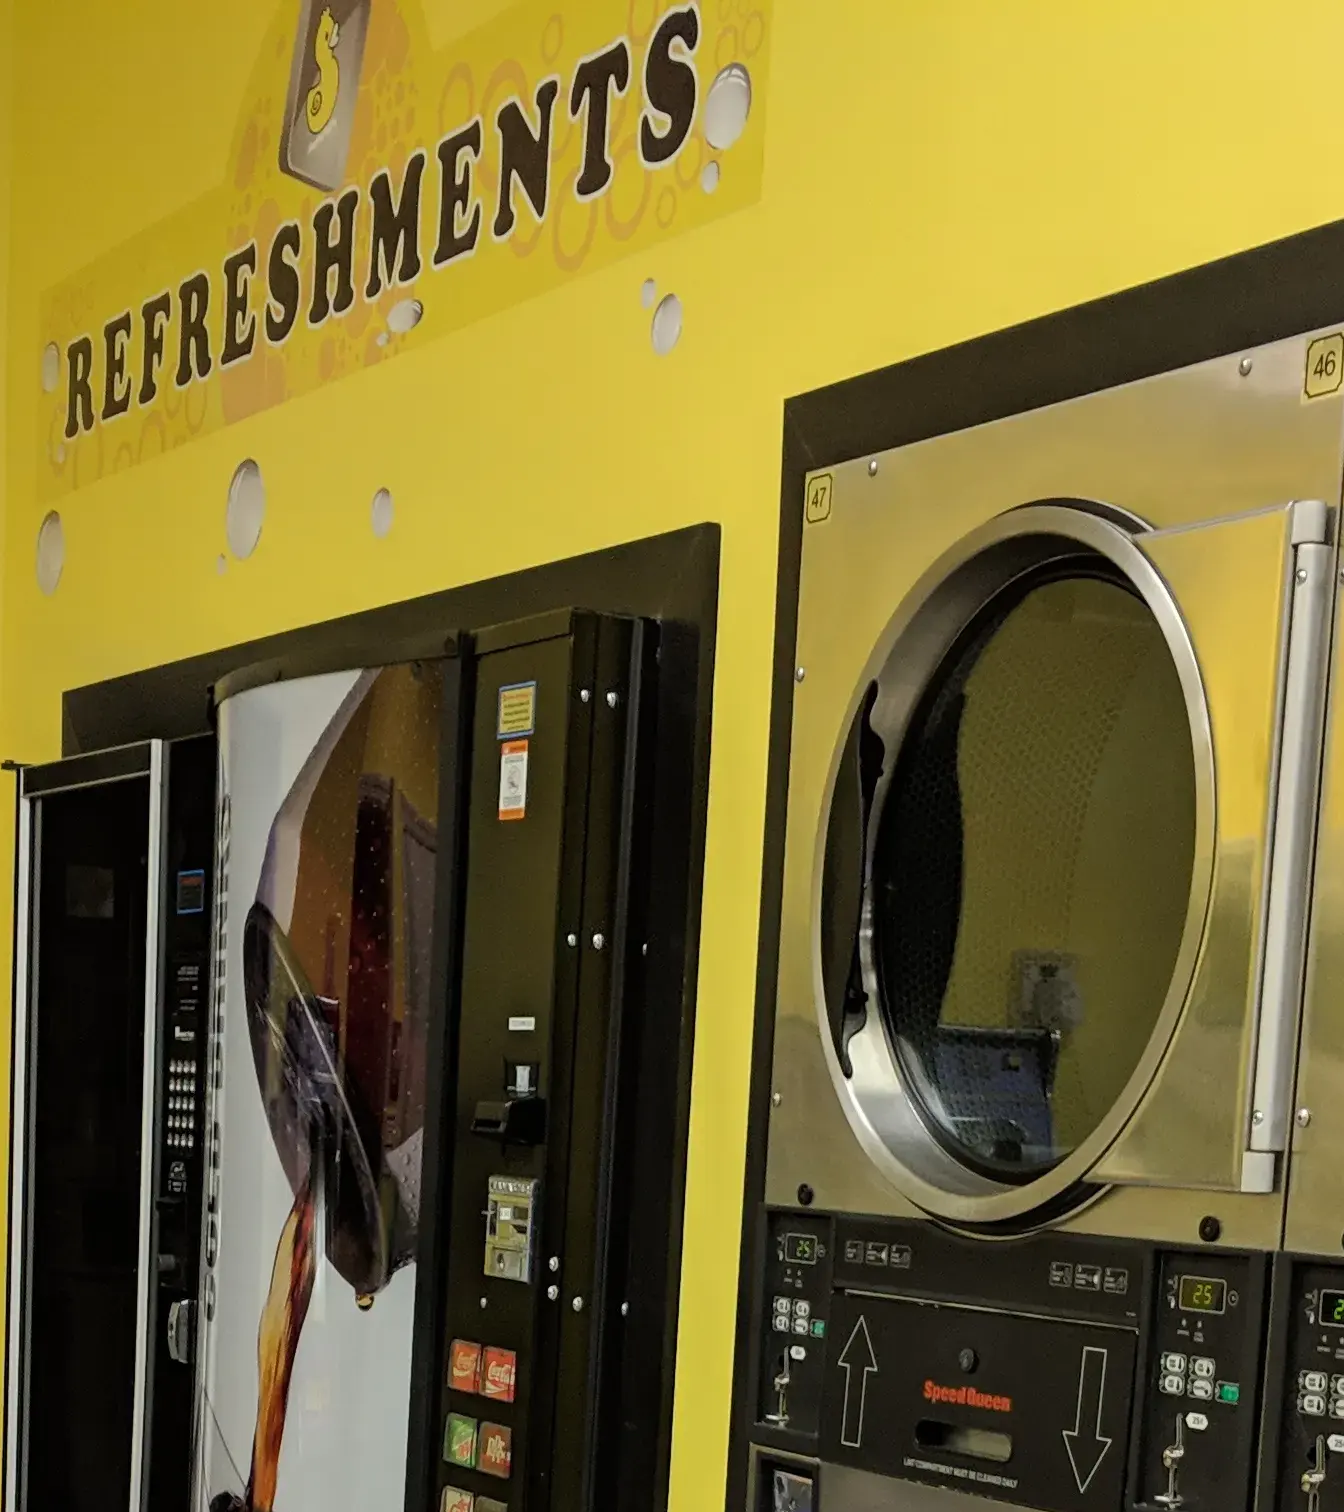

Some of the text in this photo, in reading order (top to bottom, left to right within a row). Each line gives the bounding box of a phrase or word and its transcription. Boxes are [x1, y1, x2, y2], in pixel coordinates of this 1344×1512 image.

[64, 3, 701, 439] REFRESHMENTS
[1313, 351, 1336, 380] 46
[811, 486, 828, 511] 47
[1193, 1284, 1212, 1304] 25
[923, 1379, 1012, 1413] Speed Queen
